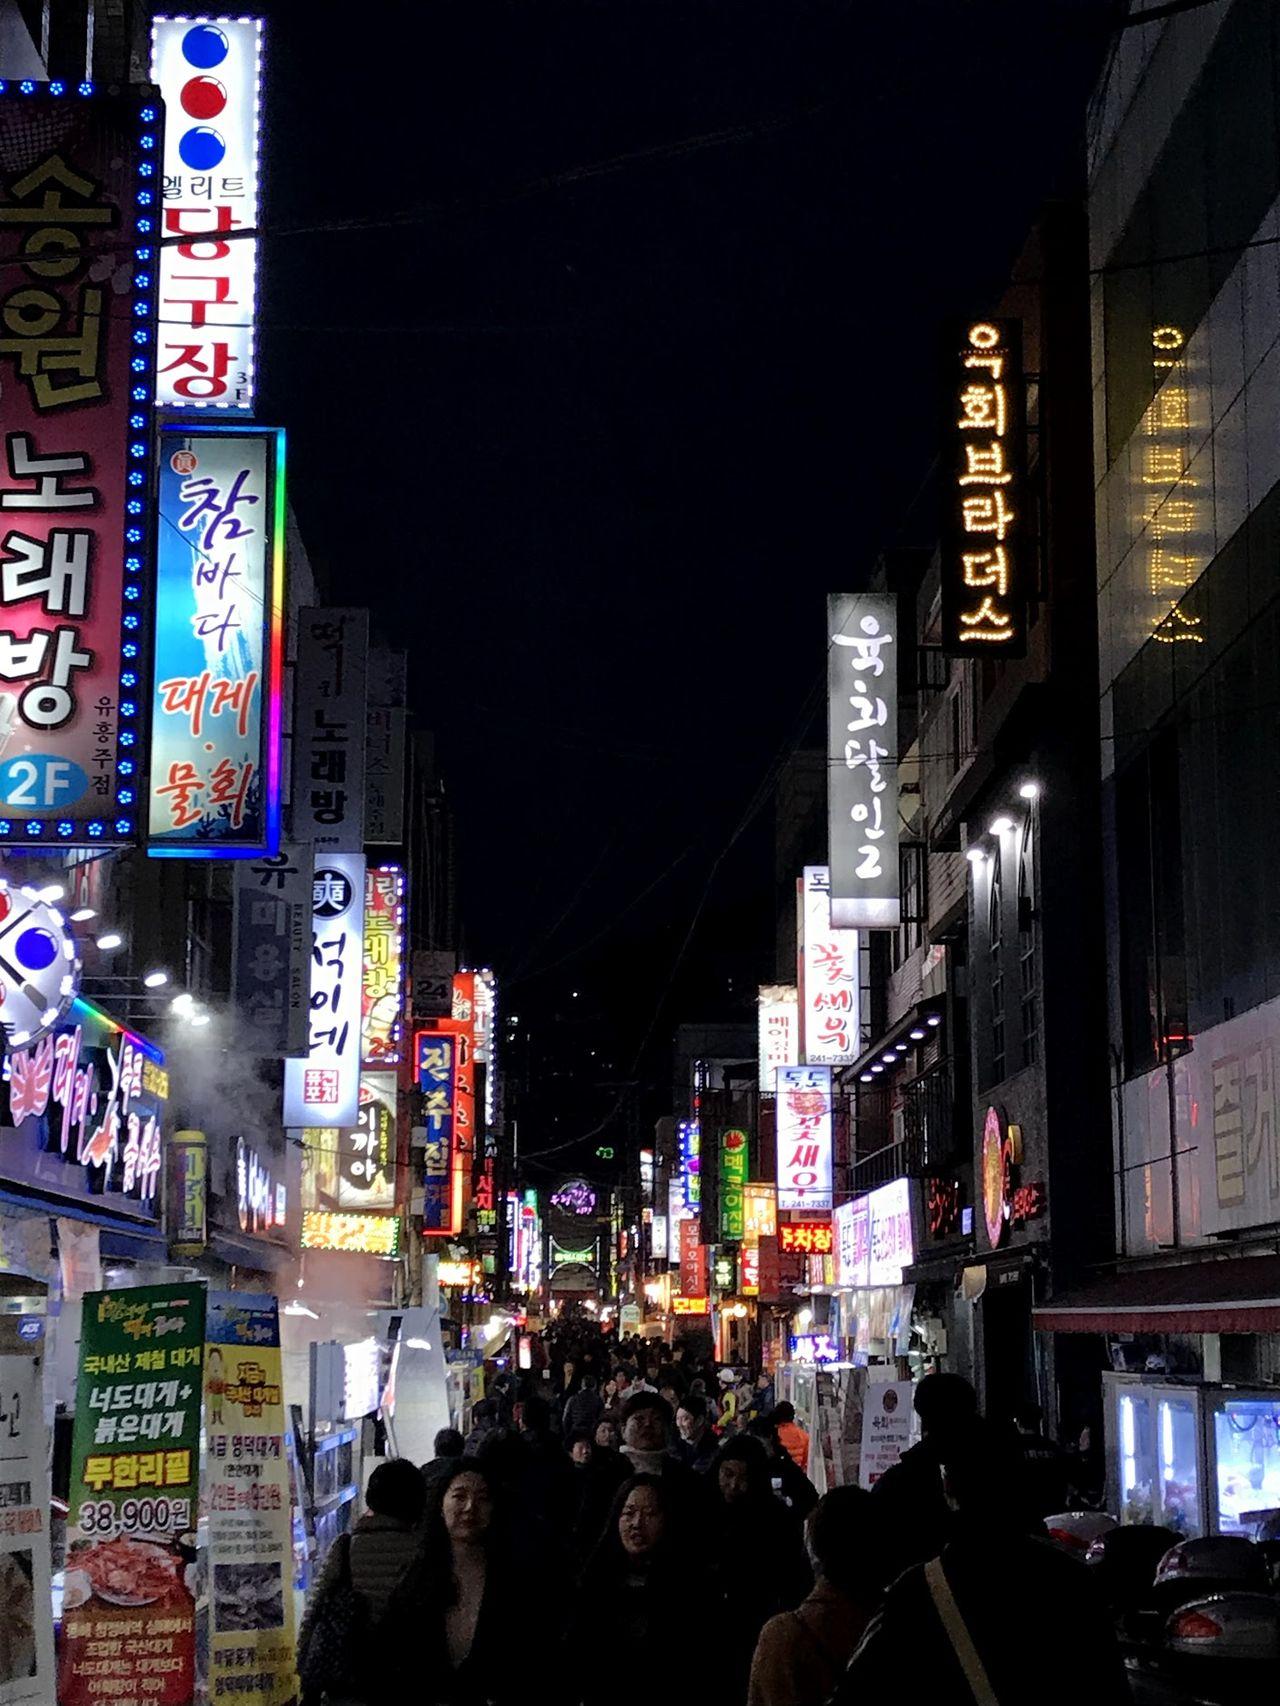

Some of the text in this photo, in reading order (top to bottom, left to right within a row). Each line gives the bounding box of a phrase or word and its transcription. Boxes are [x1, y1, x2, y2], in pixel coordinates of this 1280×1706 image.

[161, 174, 246, 201] 엘리트
[157, 205, 242, 400] 당구장
[0, 434, 95, 728] 노래방
[180, 468, 260, 653] 참바다
[158, 673, 258, 737] 대게
[91, 696, 115, 796] 유흥주점
[312, 708, 348, 825] 노래방
[6, 761, 70, 805] 2F
[155, 757, 253, 830] 물회
[292, 903, 303, 953] BEAUTY
[309, 931, 349, 1057] 석이네
[810, 943, 855, 1052] 꽃새우
[809, 1053, 855, 1063] 241-7337
[350, 1106, 379, 1183] 이까야
[420, 1042, 453, 1177] 진주집
[786, 1116, 822, 1198] 꽃새우
[791, 1200, 830, 1209] 241-7337
[83, 1345, 201, 1376] 국내산 제철 대게
[93, 1410, 187, 1445] 붉은대게
[82, 1447, 192, 1492] 무한리필
[78, 1495, 192, 1538] 38,900원
